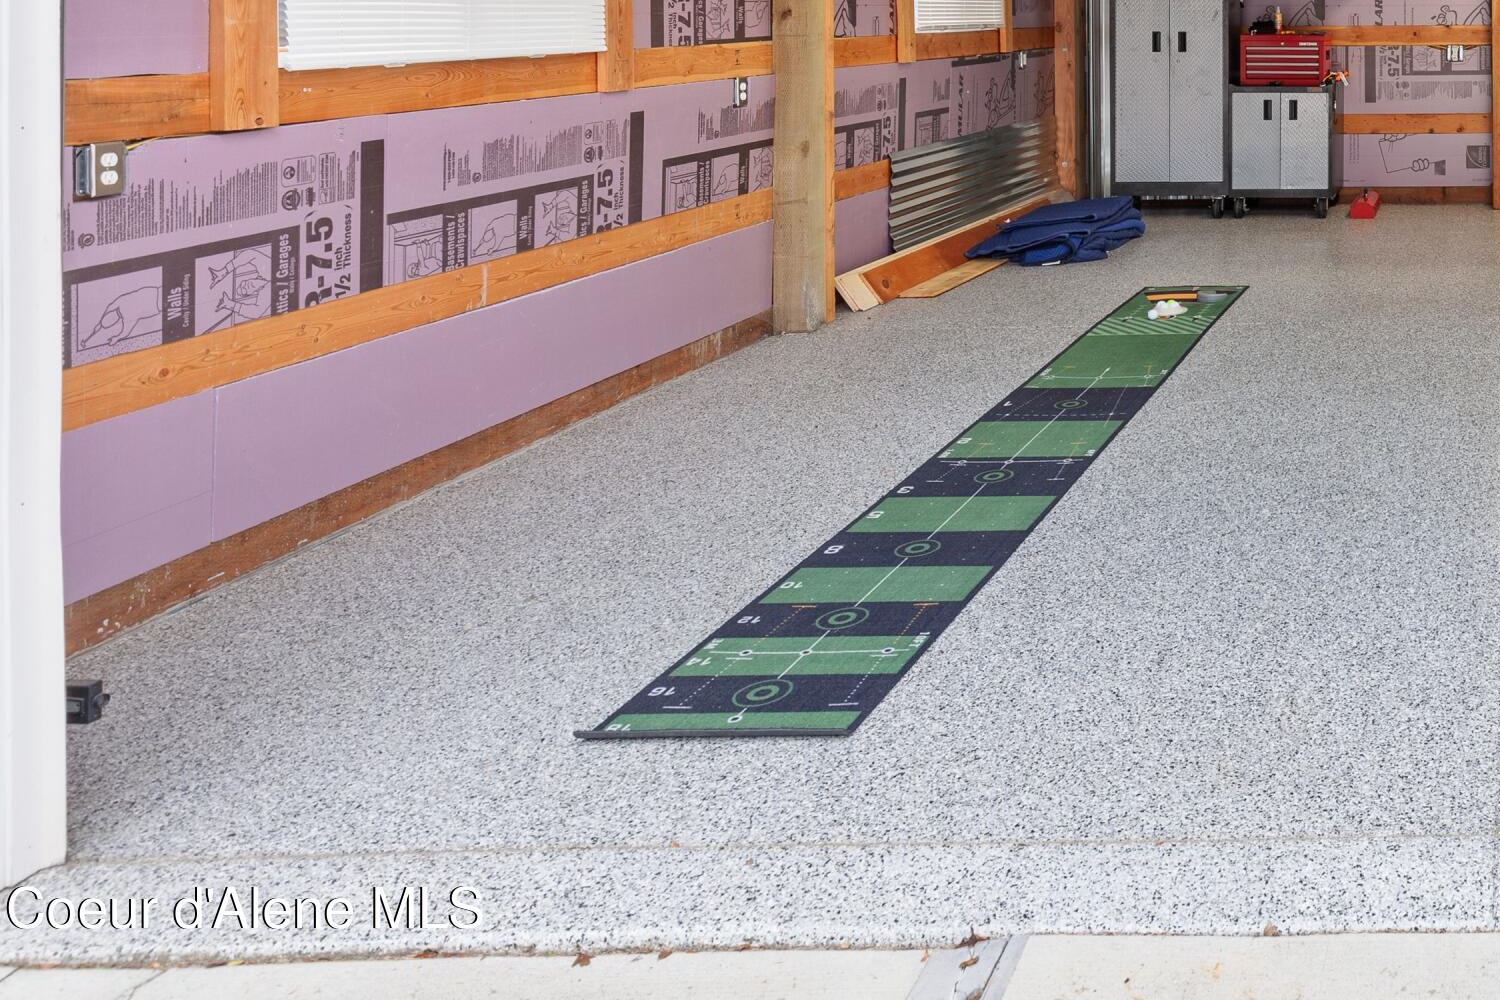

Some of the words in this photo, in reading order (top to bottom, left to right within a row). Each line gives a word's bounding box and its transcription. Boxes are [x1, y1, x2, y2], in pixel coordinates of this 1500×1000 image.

[580, 180, 589, 213] Garages
[455, 212, 466, 268] Crawlspaces
[520, 216, 528, 240] Walls
[343, 213, 352, 268] Thickness
[446, 221, 455, 271] Basements
[276, 233, 292, 278] Garages
[334, 247, 342, 271] inch
[167, 286, 182, 320] Walls
[276, 289, 289, 314] ttics
[896, 485, 915, 494] 3
[866, 510, 884, 519] 5
[824, 544, 844, 554] 8
[780, 581, 803, 589] 10
[737, 615, 761, 625] 12
[685, 656, 712, 666] 14
[647, 686, 676, 697] 16
